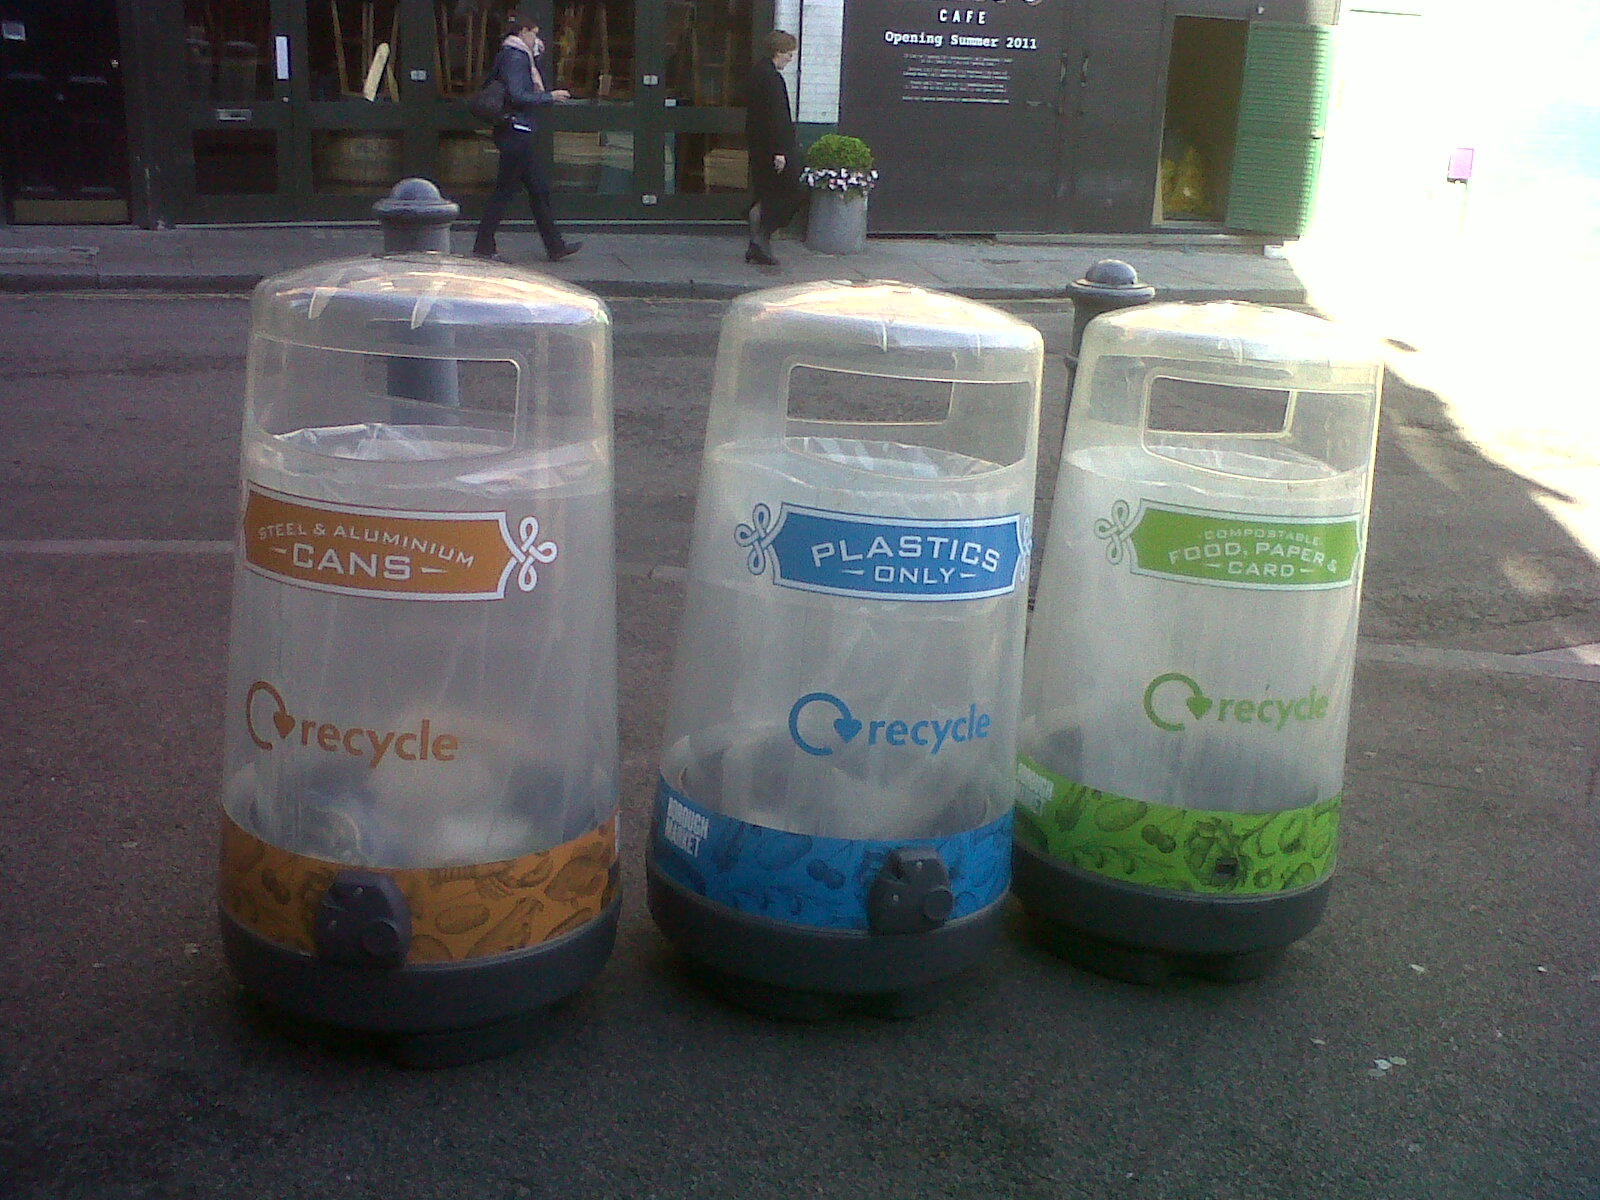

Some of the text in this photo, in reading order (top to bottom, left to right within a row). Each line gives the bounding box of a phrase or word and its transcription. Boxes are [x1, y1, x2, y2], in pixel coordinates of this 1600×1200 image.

[938, 9, 987, 25] CAFE
[884, 31, 1038, 50] Opening Summer 2011
[257, 521, 475, 569] STEEL & ALUMINIUM
[811, 535, 1000, 574] PLASTICS
[1203, 528, 1322, 547] COMPOSTABLE
[292, 542, 412, 581] CANS
[874, 565, 956, 585] ONLY
[1227, 560, 1295, 578] CARD
[1255, 541, 1326, 568] PAPER
[1326, 559, 1338, 574] &
[1217, 684, 1331, 732] recycle
[301, 718, 459, 769] recycle
[867, 702, 991, 756] recycle
